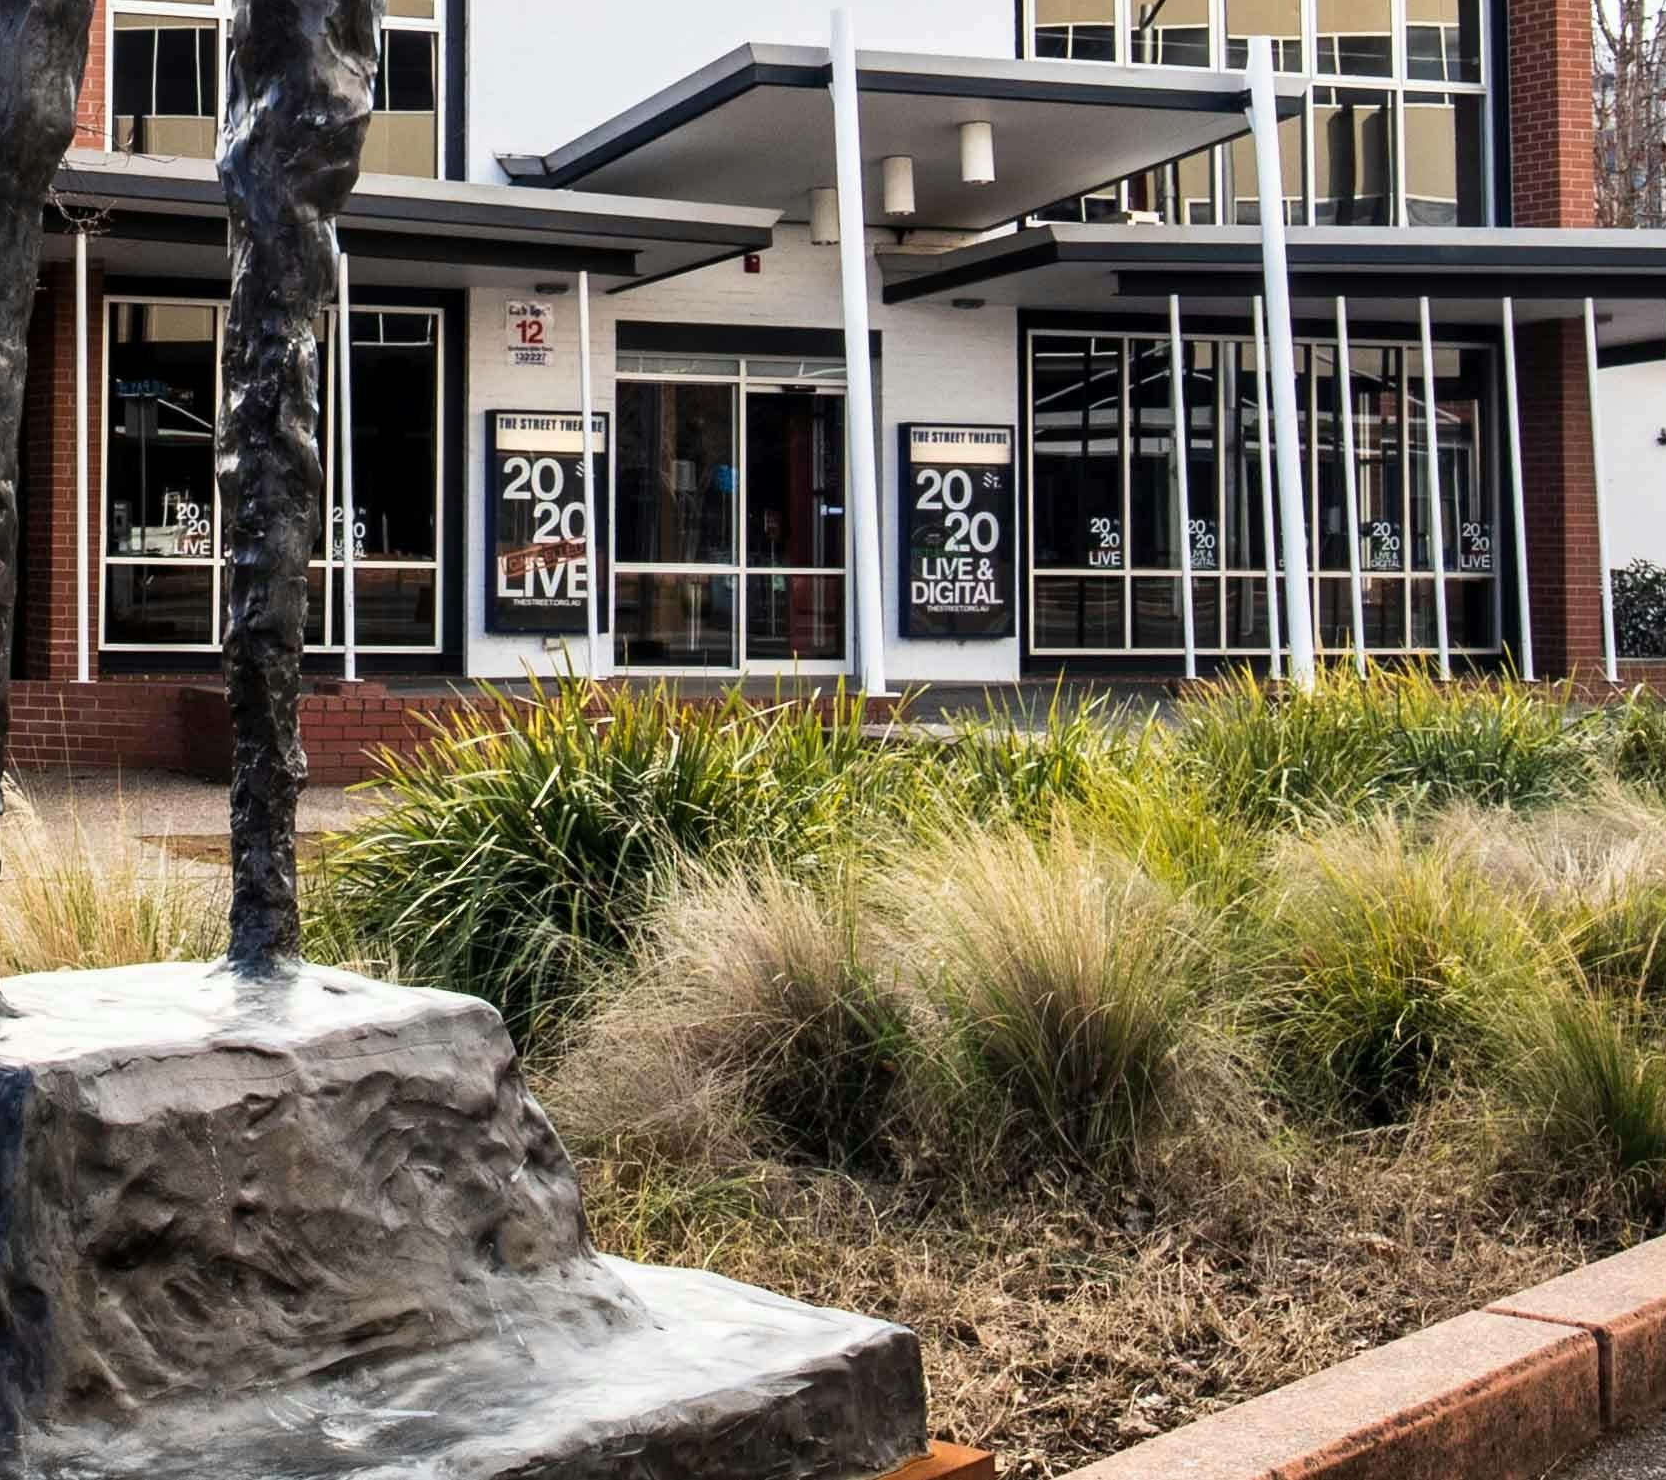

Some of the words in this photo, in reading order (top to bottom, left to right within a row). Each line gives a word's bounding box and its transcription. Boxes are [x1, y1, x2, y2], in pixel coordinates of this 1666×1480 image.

[516, 320, 543, 343] 12
[499, 417, 516, 430] THE
[520, 418, 556, 430] STREET
[560, 419, 603, 433] THEARE
[912, 431, 929, 443] THE
[932, 431, 965, 443] STREET
[968, 432, 1007, 445] THEATRE
[502, 457, 564, 501] 20
[916, 469, 972, 510] 20
[176, 503, 199, 519] 20
[187, 520, 210, 535] 20
[533, 501, 587, 544] 20
[1090, 518, 1110, 533] 20
[1188, 520, 1206, 535] 20
[1372, 522, 1390, 536] 20
[1462, 523, 1480, 537] 20
[944, 511, 999, 553] 20
[1100, 533, 1120, 548] 20
[1196, 534, 1214, 549] 20
[1381, 536, 1400, 550] 20
[1471, 537, 1490, 551] 20
[1089, 551, 1121, 565] LIVE
[1461, 554, 1491, 567] LIVE
[497, 556, 588, 597] LIVE
[922, 558, 973, 580] LIVE
[977, 558, 994, 580] &
[911, 581, 1004, 604] DIGITAL
